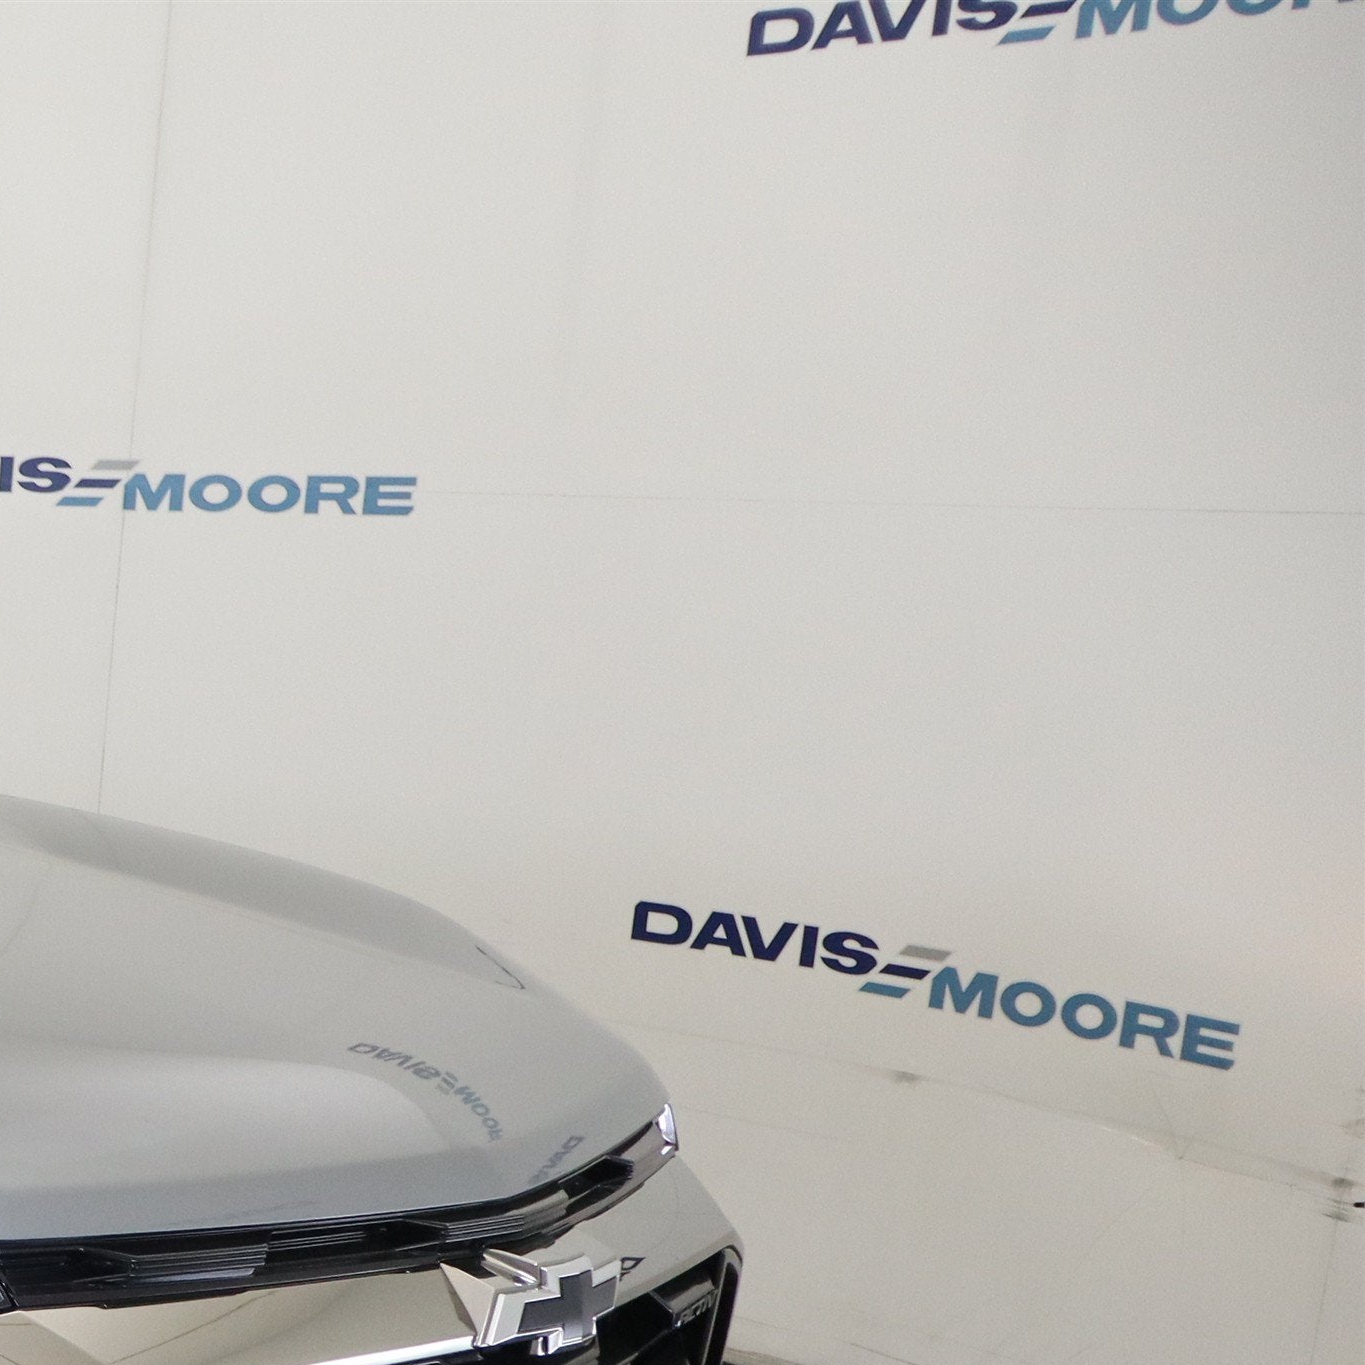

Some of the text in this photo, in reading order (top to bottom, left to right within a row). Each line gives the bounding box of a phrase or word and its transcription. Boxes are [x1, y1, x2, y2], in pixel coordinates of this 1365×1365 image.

[746, 0, 1017, 57] DAVIS
[122, 473, 418, 516] MOORE
[630, 900, 1241, 1071] DAVIS MOORE
